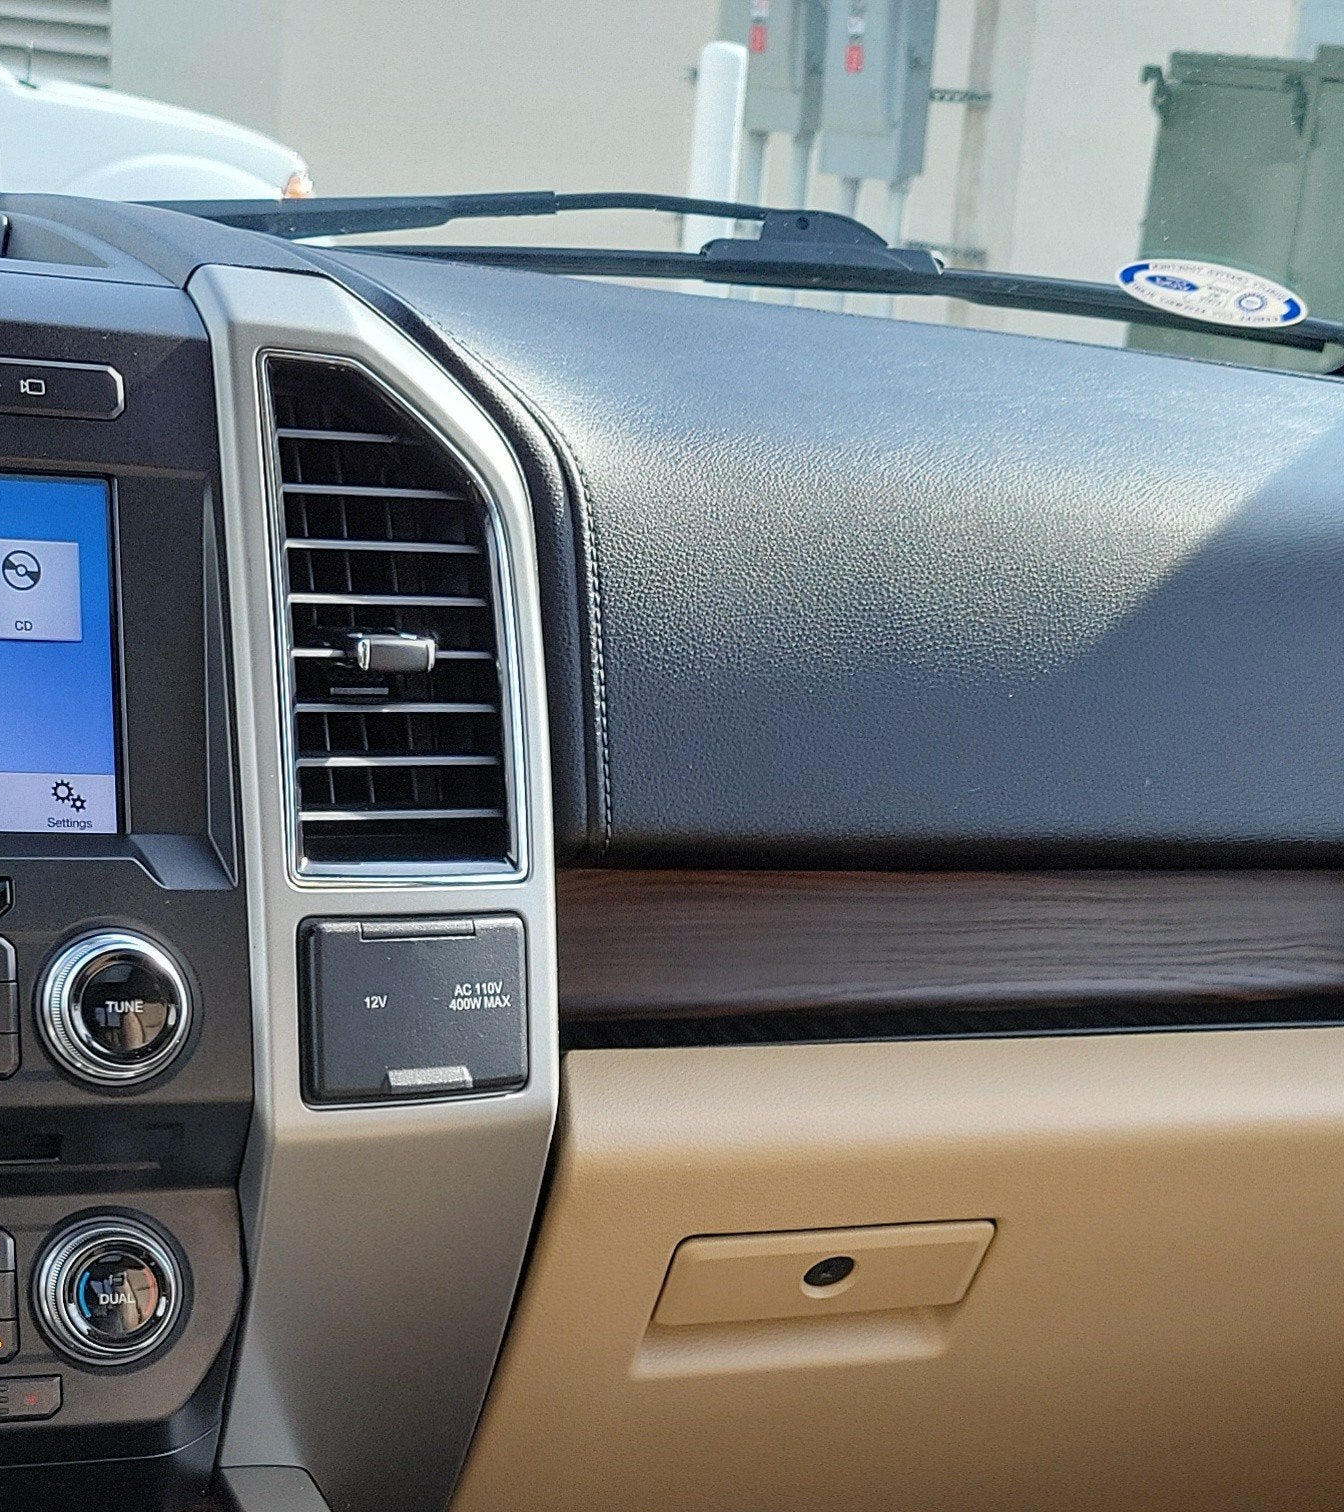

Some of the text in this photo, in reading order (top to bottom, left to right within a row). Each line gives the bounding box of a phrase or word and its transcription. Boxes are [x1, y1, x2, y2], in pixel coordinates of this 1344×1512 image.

[13, 619, 34, 632] CD
[47, 816, 93, 832] Settings
[454, 981, 503, 997] AC 110V
[105, 1000, 145, 1014] TUNE
[363, 995, 388, 1010] 12V
[449, 995, 511, 1012] 400W MAX
[99, 1292, 136, 1306] DUAL
